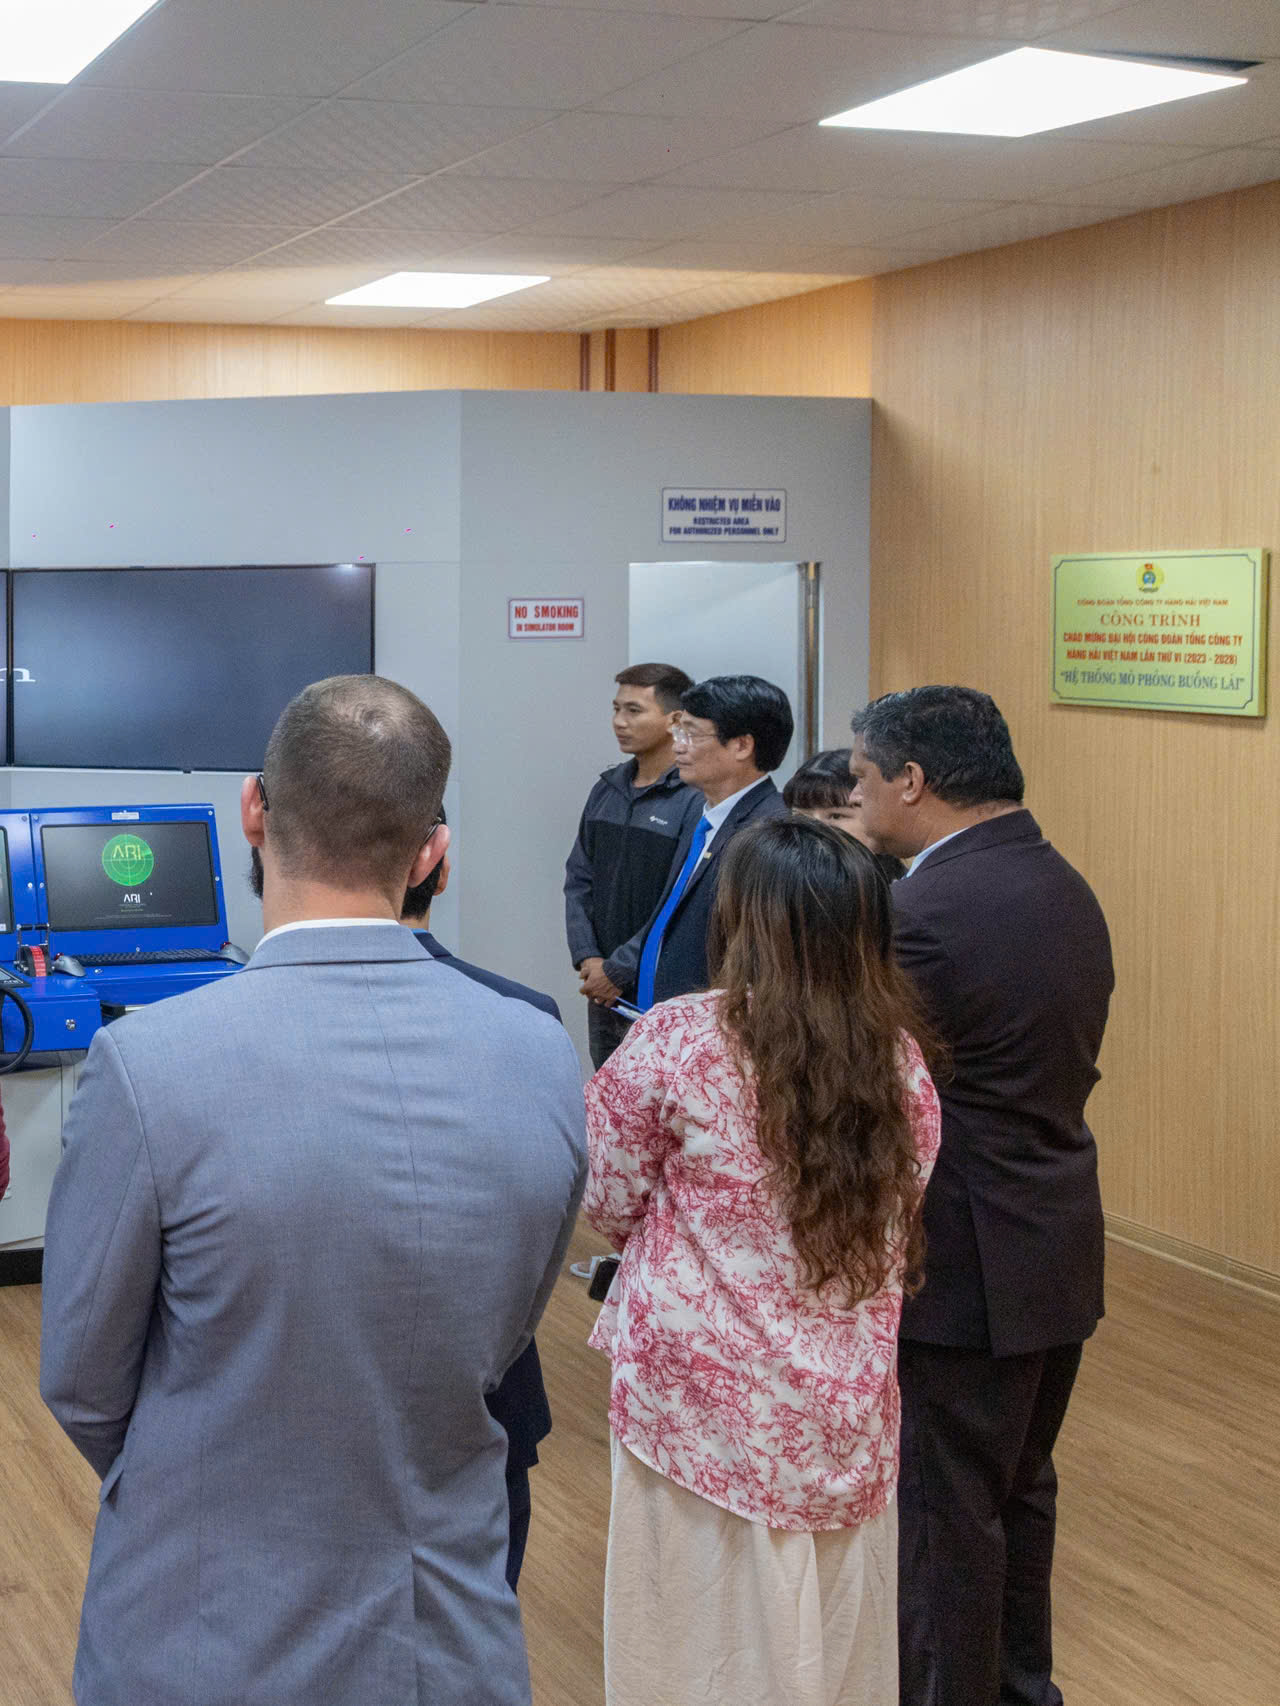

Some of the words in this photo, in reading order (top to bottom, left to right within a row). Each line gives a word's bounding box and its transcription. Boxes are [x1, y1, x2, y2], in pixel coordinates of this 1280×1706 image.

[668, 494, 696, 511] KHÔNG
[699, 495, 726, 514] NHIỆM
[729, 498, 739, 514] VỤ
[765, 496, 781, 512] VÀO
[693, 517, 731, 525] RESTRICTED
[733, 517, 750, 525] AREA
[669, 527, 681, 535] FOR
[683, 527, 722, 535] AUTHORIZED
[724, 527, 760, 535] PERSONNEL
[763, 527, 779, 536] ONLY
[515, 605, 527, 619] NO
[535, 605, 578, 619] SMOKING
[1100, 610, 1144, 626] CÔNG
[1150, 610, 1200, 627] TRÌNH
[516, 623, 522, 632] IN
[524, 623, 556, 632] SIMULATOR
[558, 623, 575, 632] ROOM
[1233, 635, 1243, 646] TY
[1120, 650, 1138, 662] NAM
[1174, 652, 1182, 663] VI
[113, 844, 141, 860] ARI
[123, 893, 141, 903] ARI
